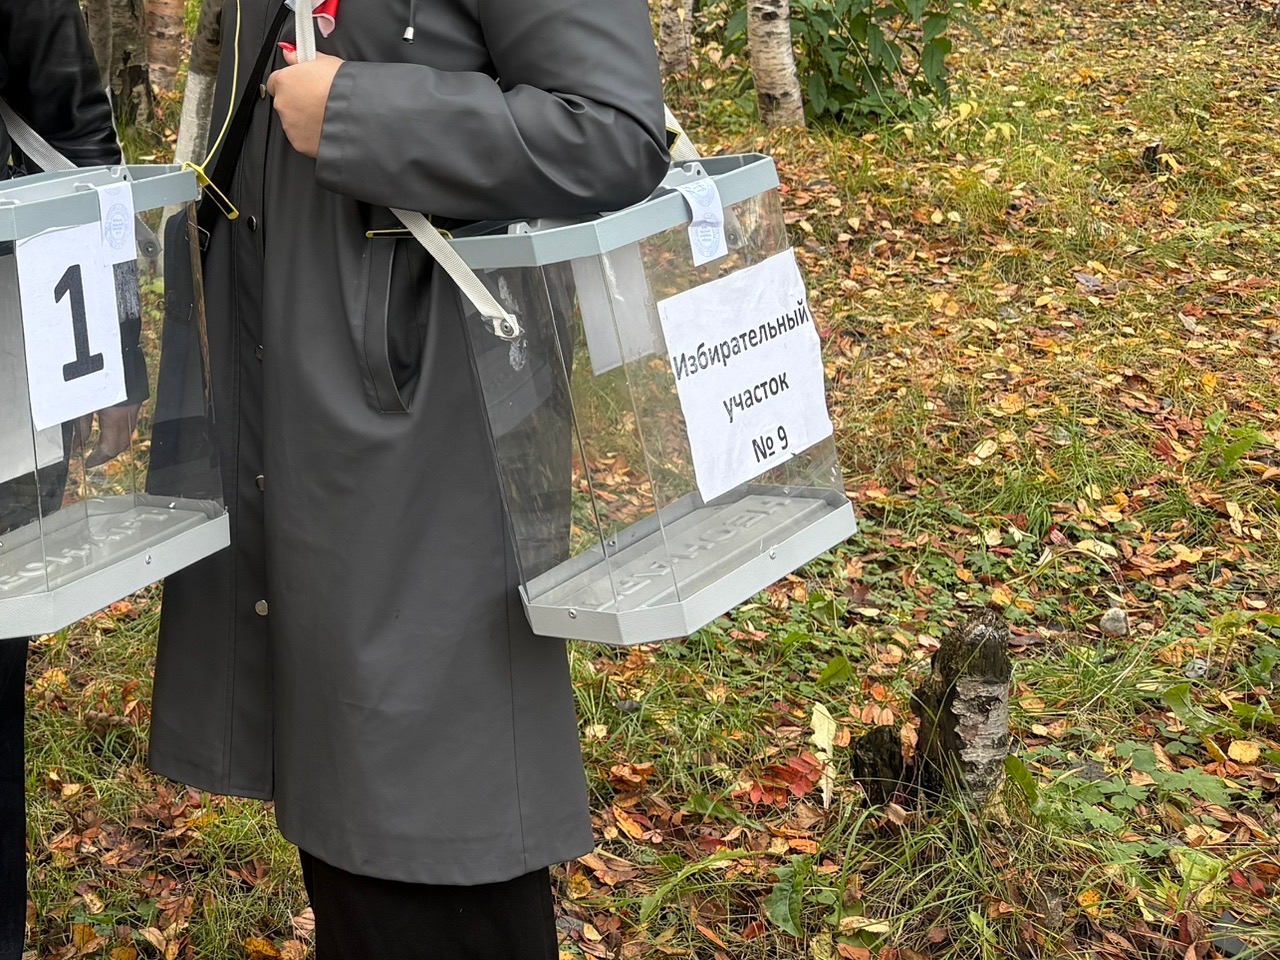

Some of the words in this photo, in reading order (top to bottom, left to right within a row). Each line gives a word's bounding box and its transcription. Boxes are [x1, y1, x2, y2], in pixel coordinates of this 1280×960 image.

[53, 263, 105, 383] 1
[672, 298, 809, 381] Избирательный
[722, 372, 790, 424] участок
[751, 434, 776, 463] №
[777, 425, 789, 450] 9
